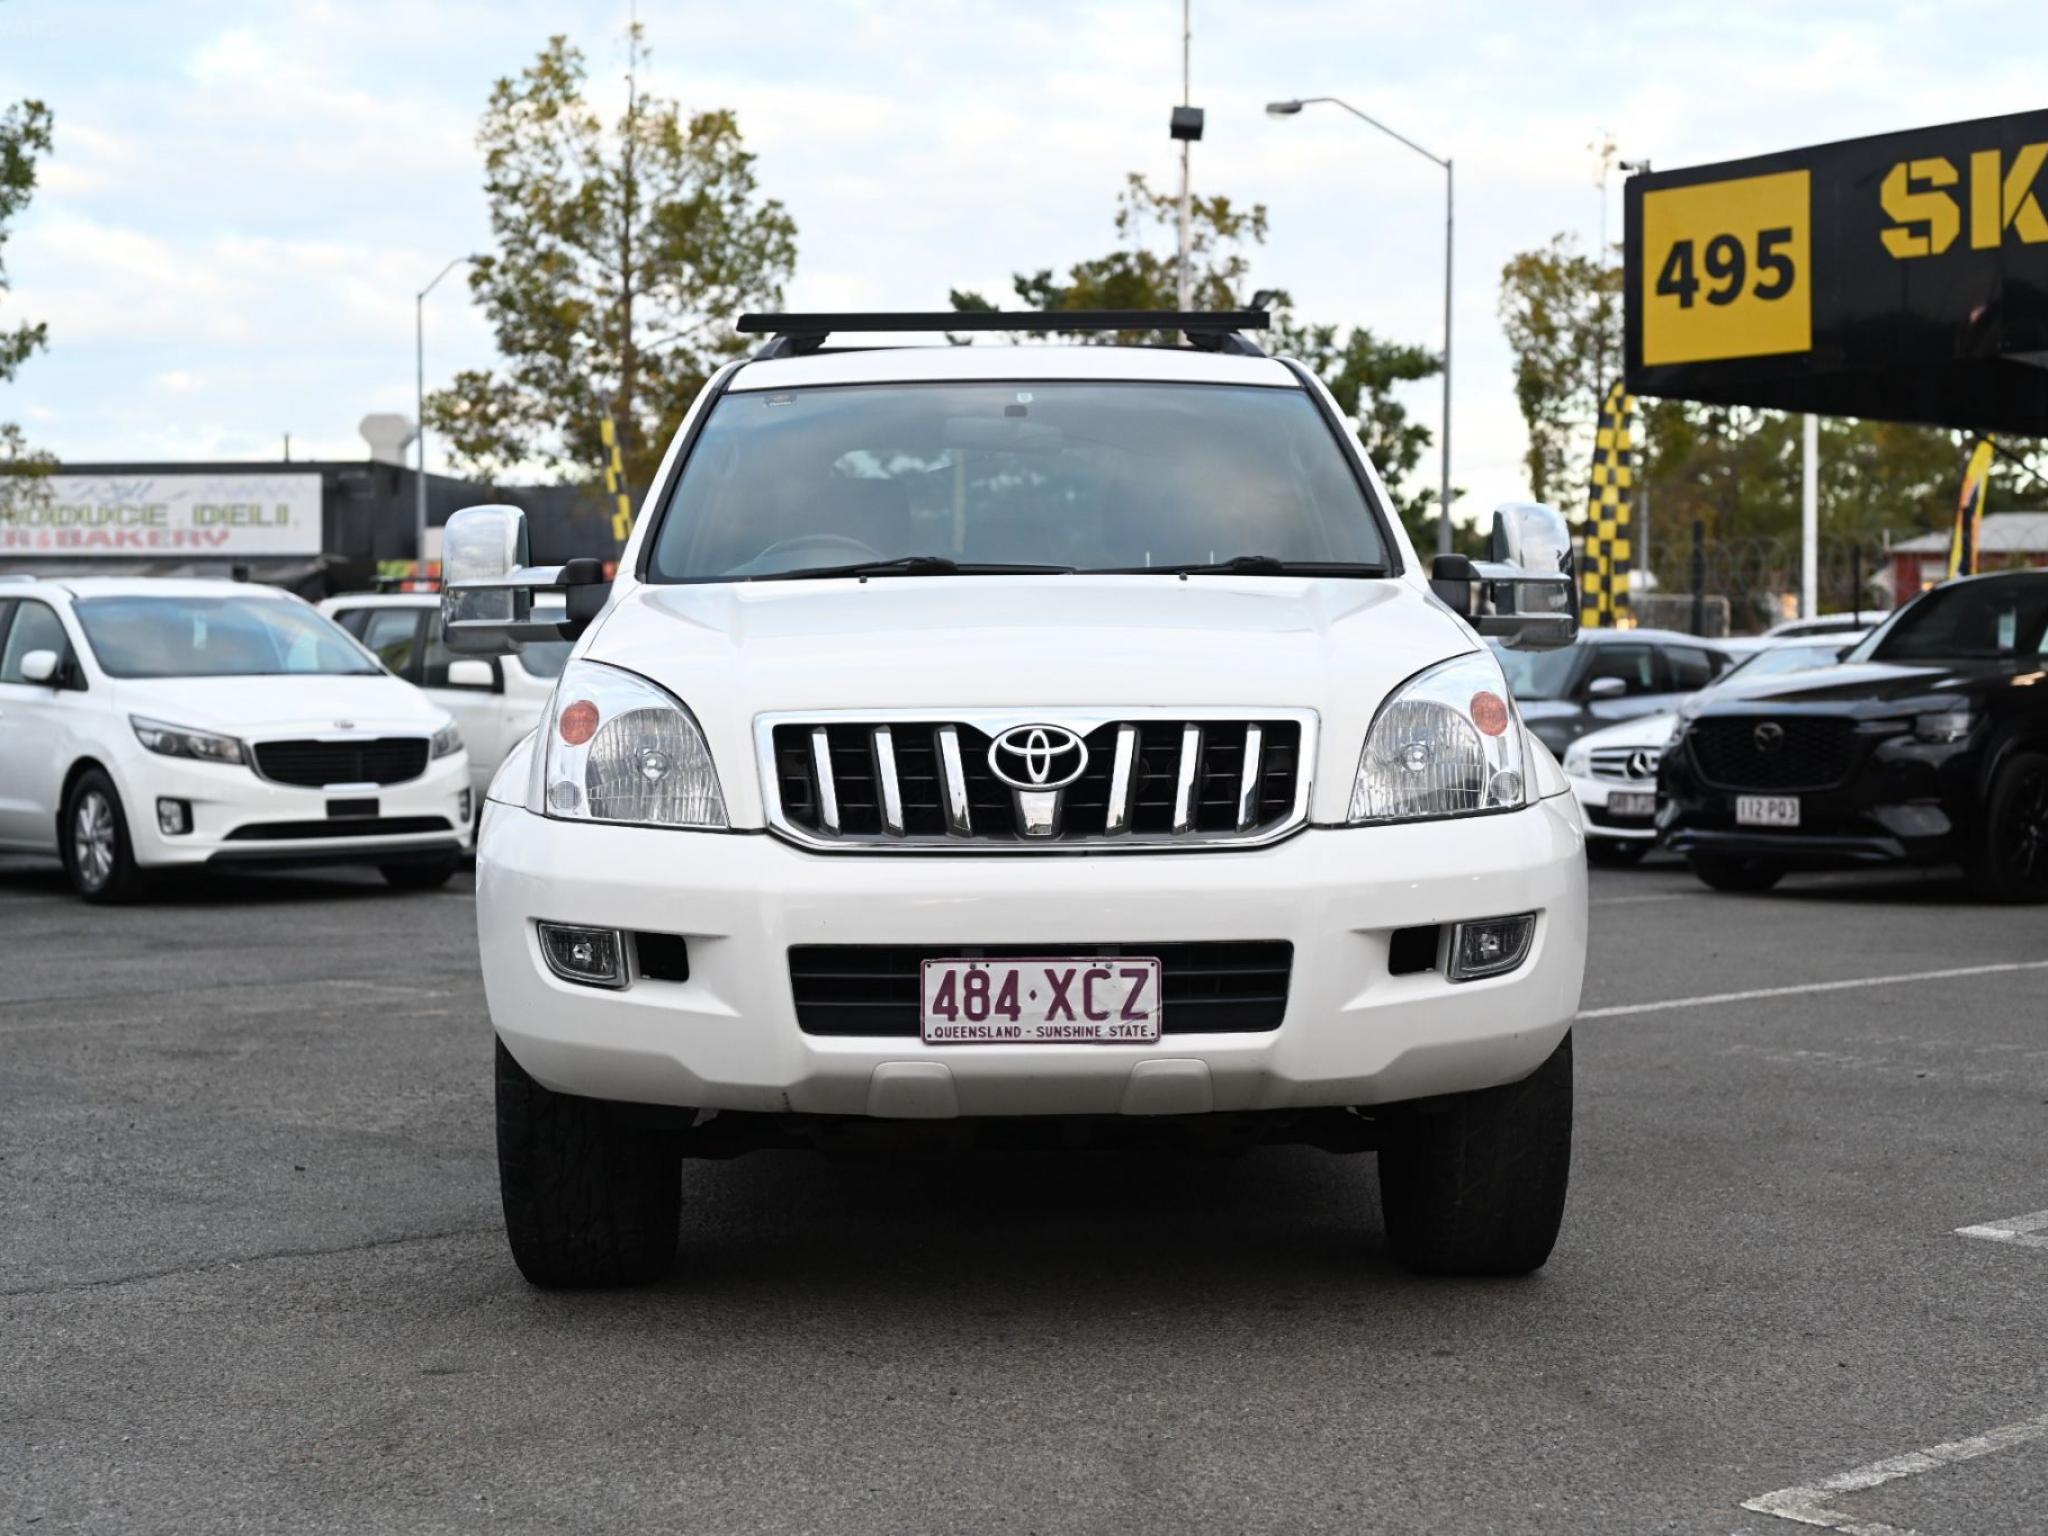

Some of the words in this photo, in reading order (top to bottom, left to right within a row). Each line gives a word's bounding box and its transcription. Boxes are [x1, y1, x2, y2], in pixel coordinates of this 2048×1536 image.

[1880, 141, 2048, 259] SK
[1656, 226, 1795, 309] 495
[934, 1025, 1021, 1038] QUEENSLAND
[1036, 1025, 1101, 1038] SUNSHINE
[1109, 1025, 1148, 1038] STATE
